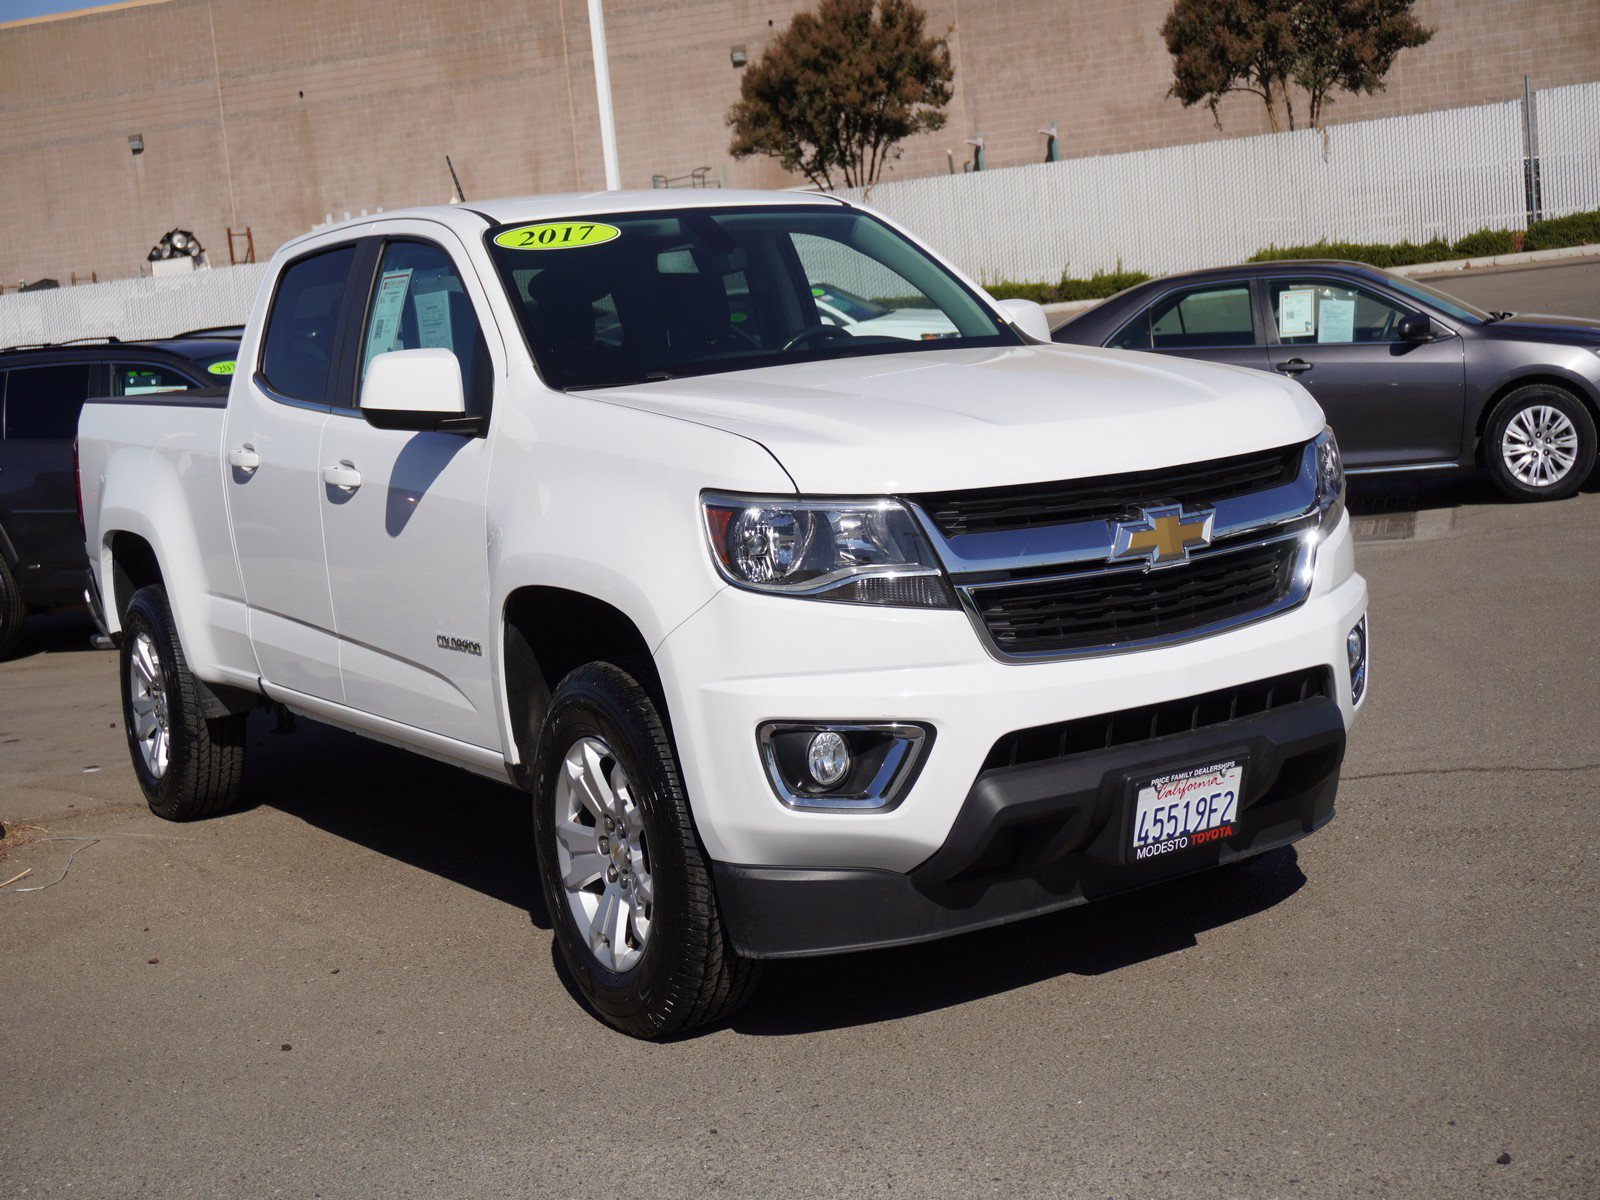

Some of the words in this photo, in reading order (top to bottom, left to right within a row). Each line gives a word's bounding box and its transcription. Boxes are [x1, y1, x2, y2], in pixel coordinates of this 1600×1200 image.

[518, 226, 595, 246] 2017
[1151, 777, 1169, 786] PRICE
[1171, 771, 1193, 784] FAMILY
[1194, 761, 1236, 776] DEALERSHIPS
[1156, 776, 1224, 801] California
[1137, 790, 1235, 846] 45519F2
[1137, 837, 1188, 860] MODESTO
[1191, 826, 1233, 845] TOYOTA
